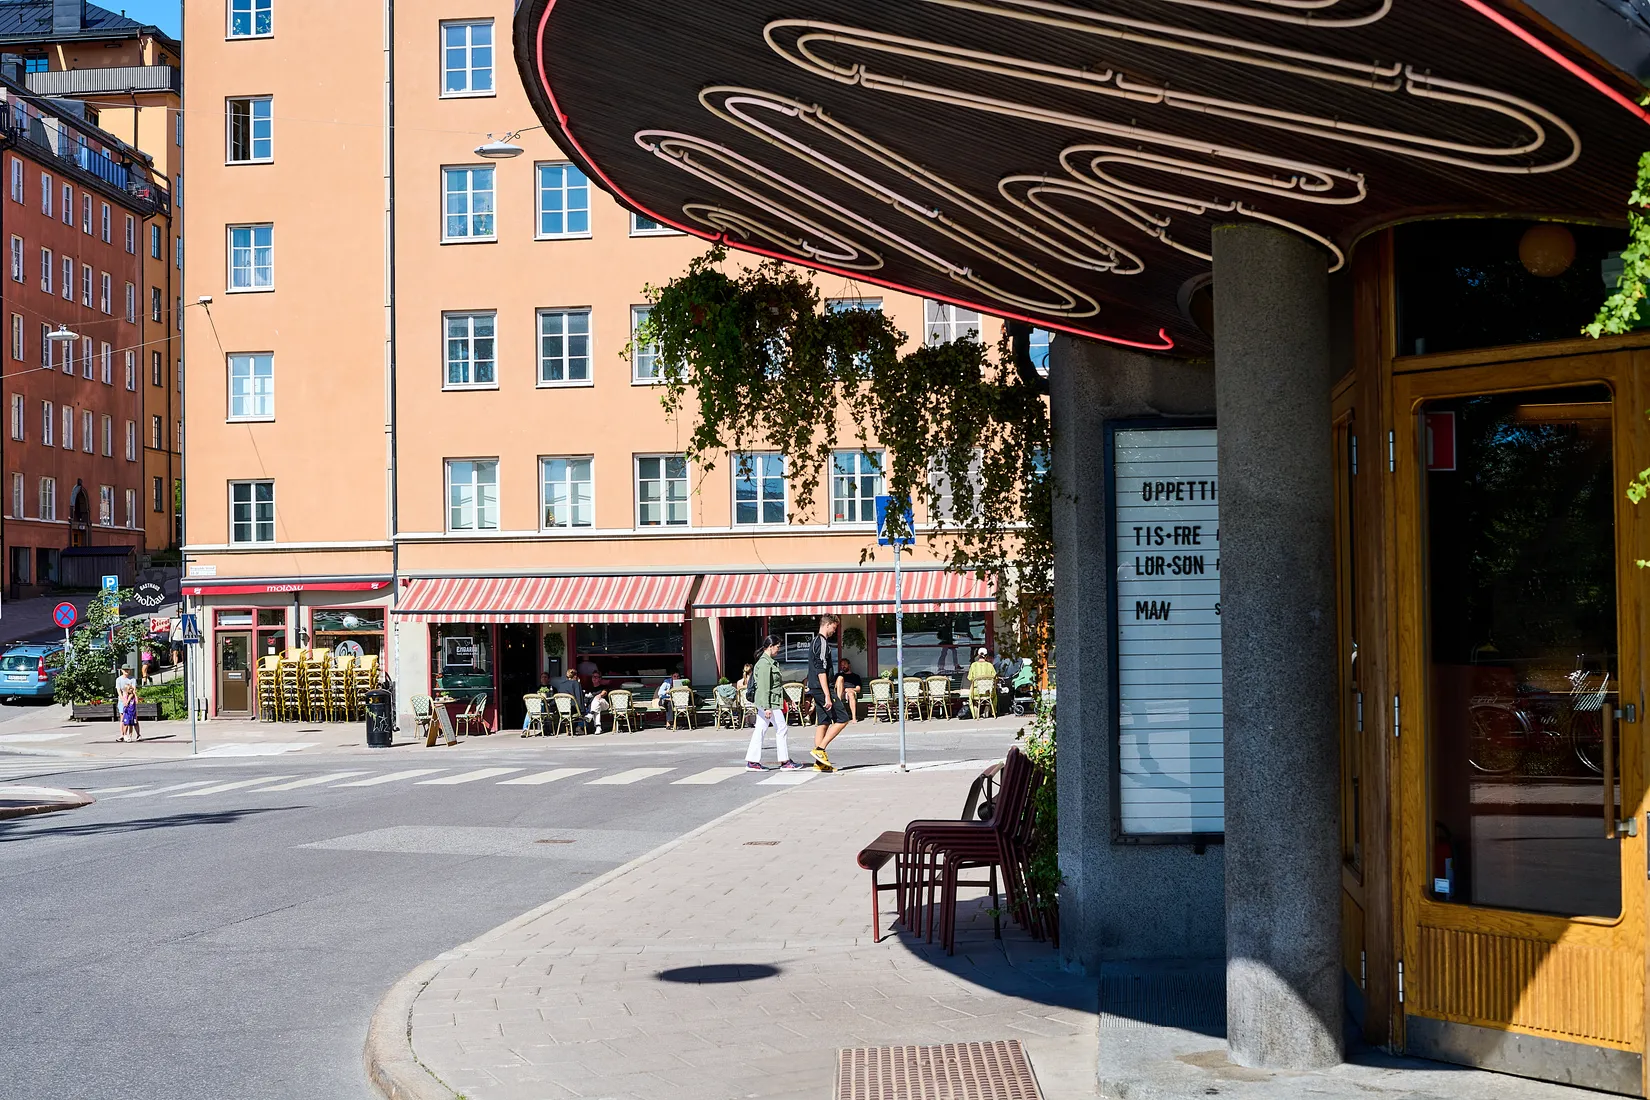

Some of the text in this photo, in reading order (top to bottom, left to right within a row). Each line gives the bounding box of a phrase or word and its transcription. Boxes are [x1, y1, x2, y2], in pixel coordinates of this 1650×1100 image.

[106, 577, 115, 588] P
[139, 582, 161, 592] GASTHAUS
[266, 584, 304, 592] moldau
[133, 592, 166, 607] moldau
[1135, 600, 1171, 621] MÅN
